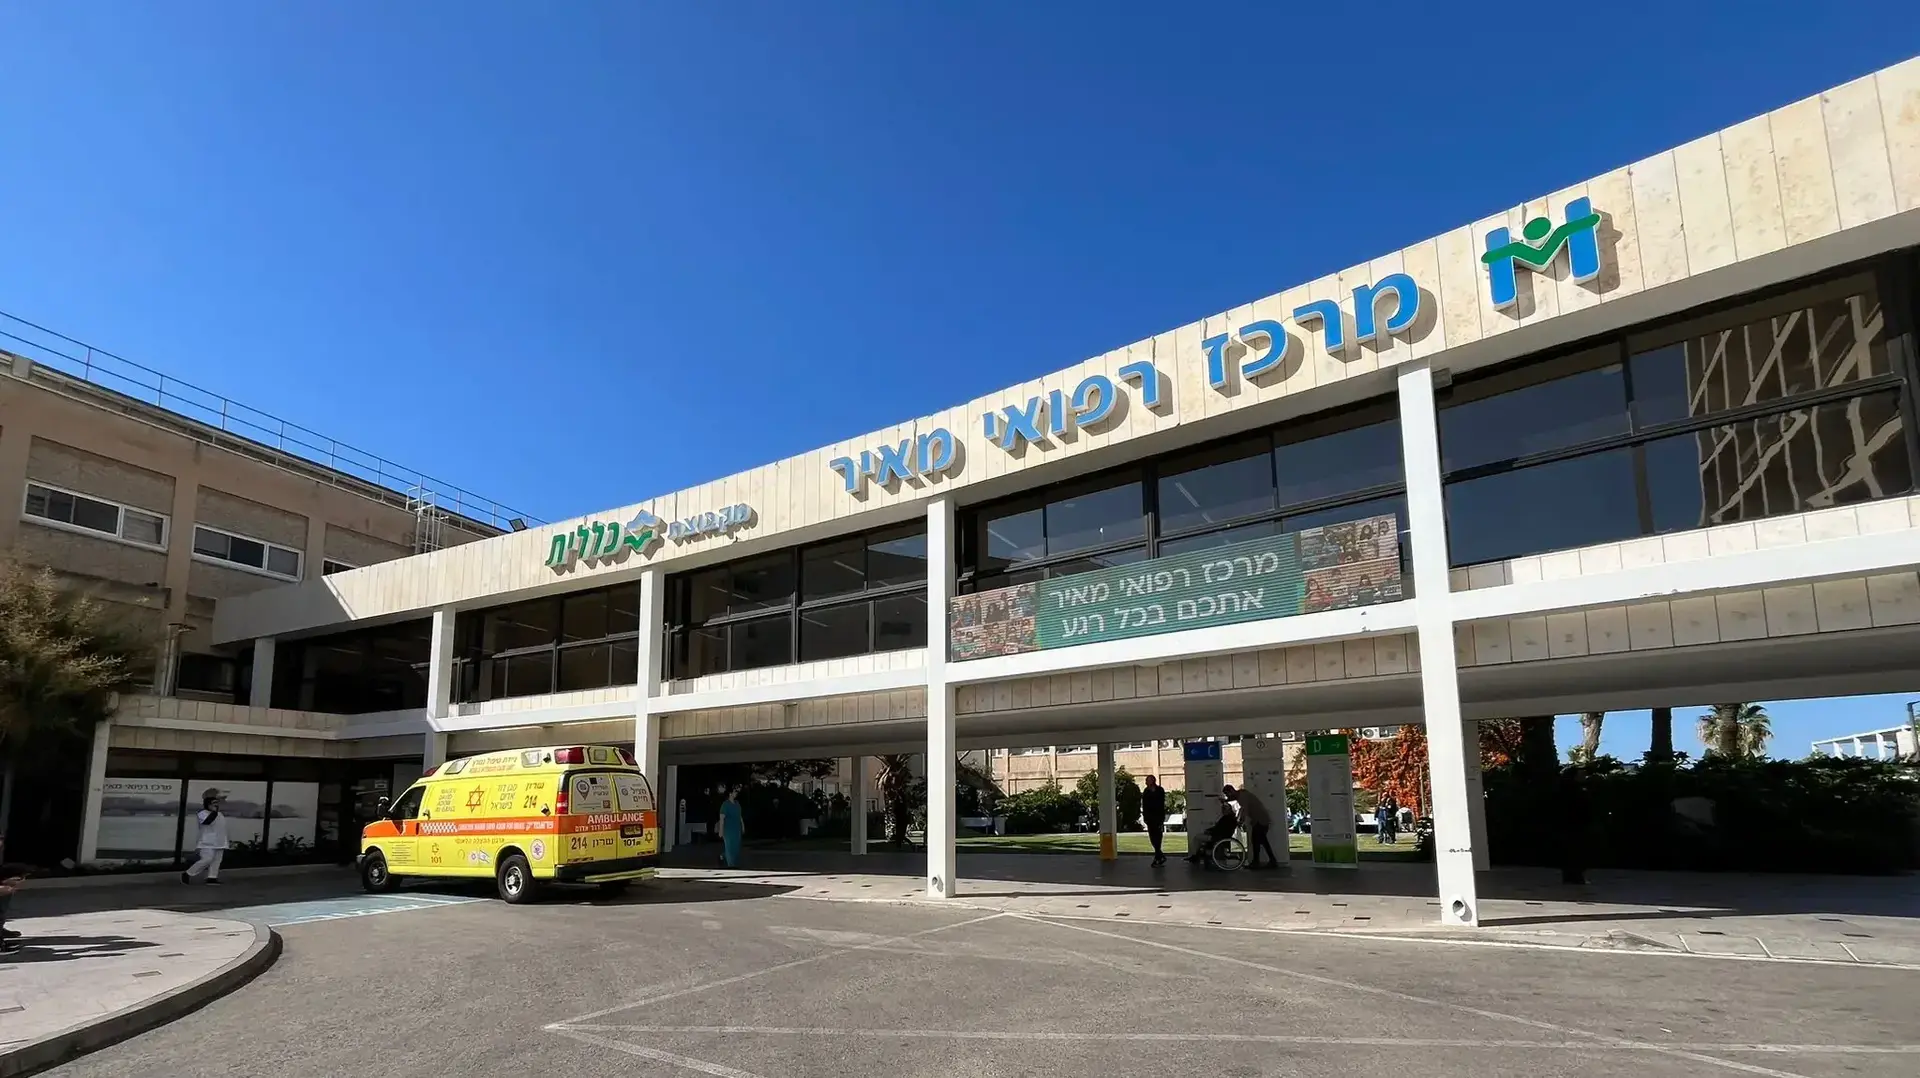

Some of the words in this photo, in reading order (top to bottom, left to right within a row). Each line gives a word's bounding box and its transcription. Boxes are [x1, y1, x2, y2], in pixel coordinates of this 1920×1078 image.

[1201, 272, 1421, 391] מרכז
[982, 360, 1161, 452] רפואי
[829, 427, 957, 495] מאיר
[667, 503, 751, 542] מקבוצת
[545, 520, 625, 568] כללית
[1201, 552, 1279, 583] מרכז
[1048, 582, 1110, 608] מאיר
[1119, 568, 1191, 597] רפואי
[1114, 604, 1167, 629] בכל
[1177, 588, 1265, 621] אתכם
[1061, 614, 1105, 638] רגע
[525, 782, 545, 791] שרון
[523, 795, 538, 809] 214
[587, 812, 644, 824] AMBULANCE
[571, 836, 588, 850] 214
[592, 838, 614, 848] שרון
[623, 838, 636, 847] 101
[430, 856, 442, 864] 101
